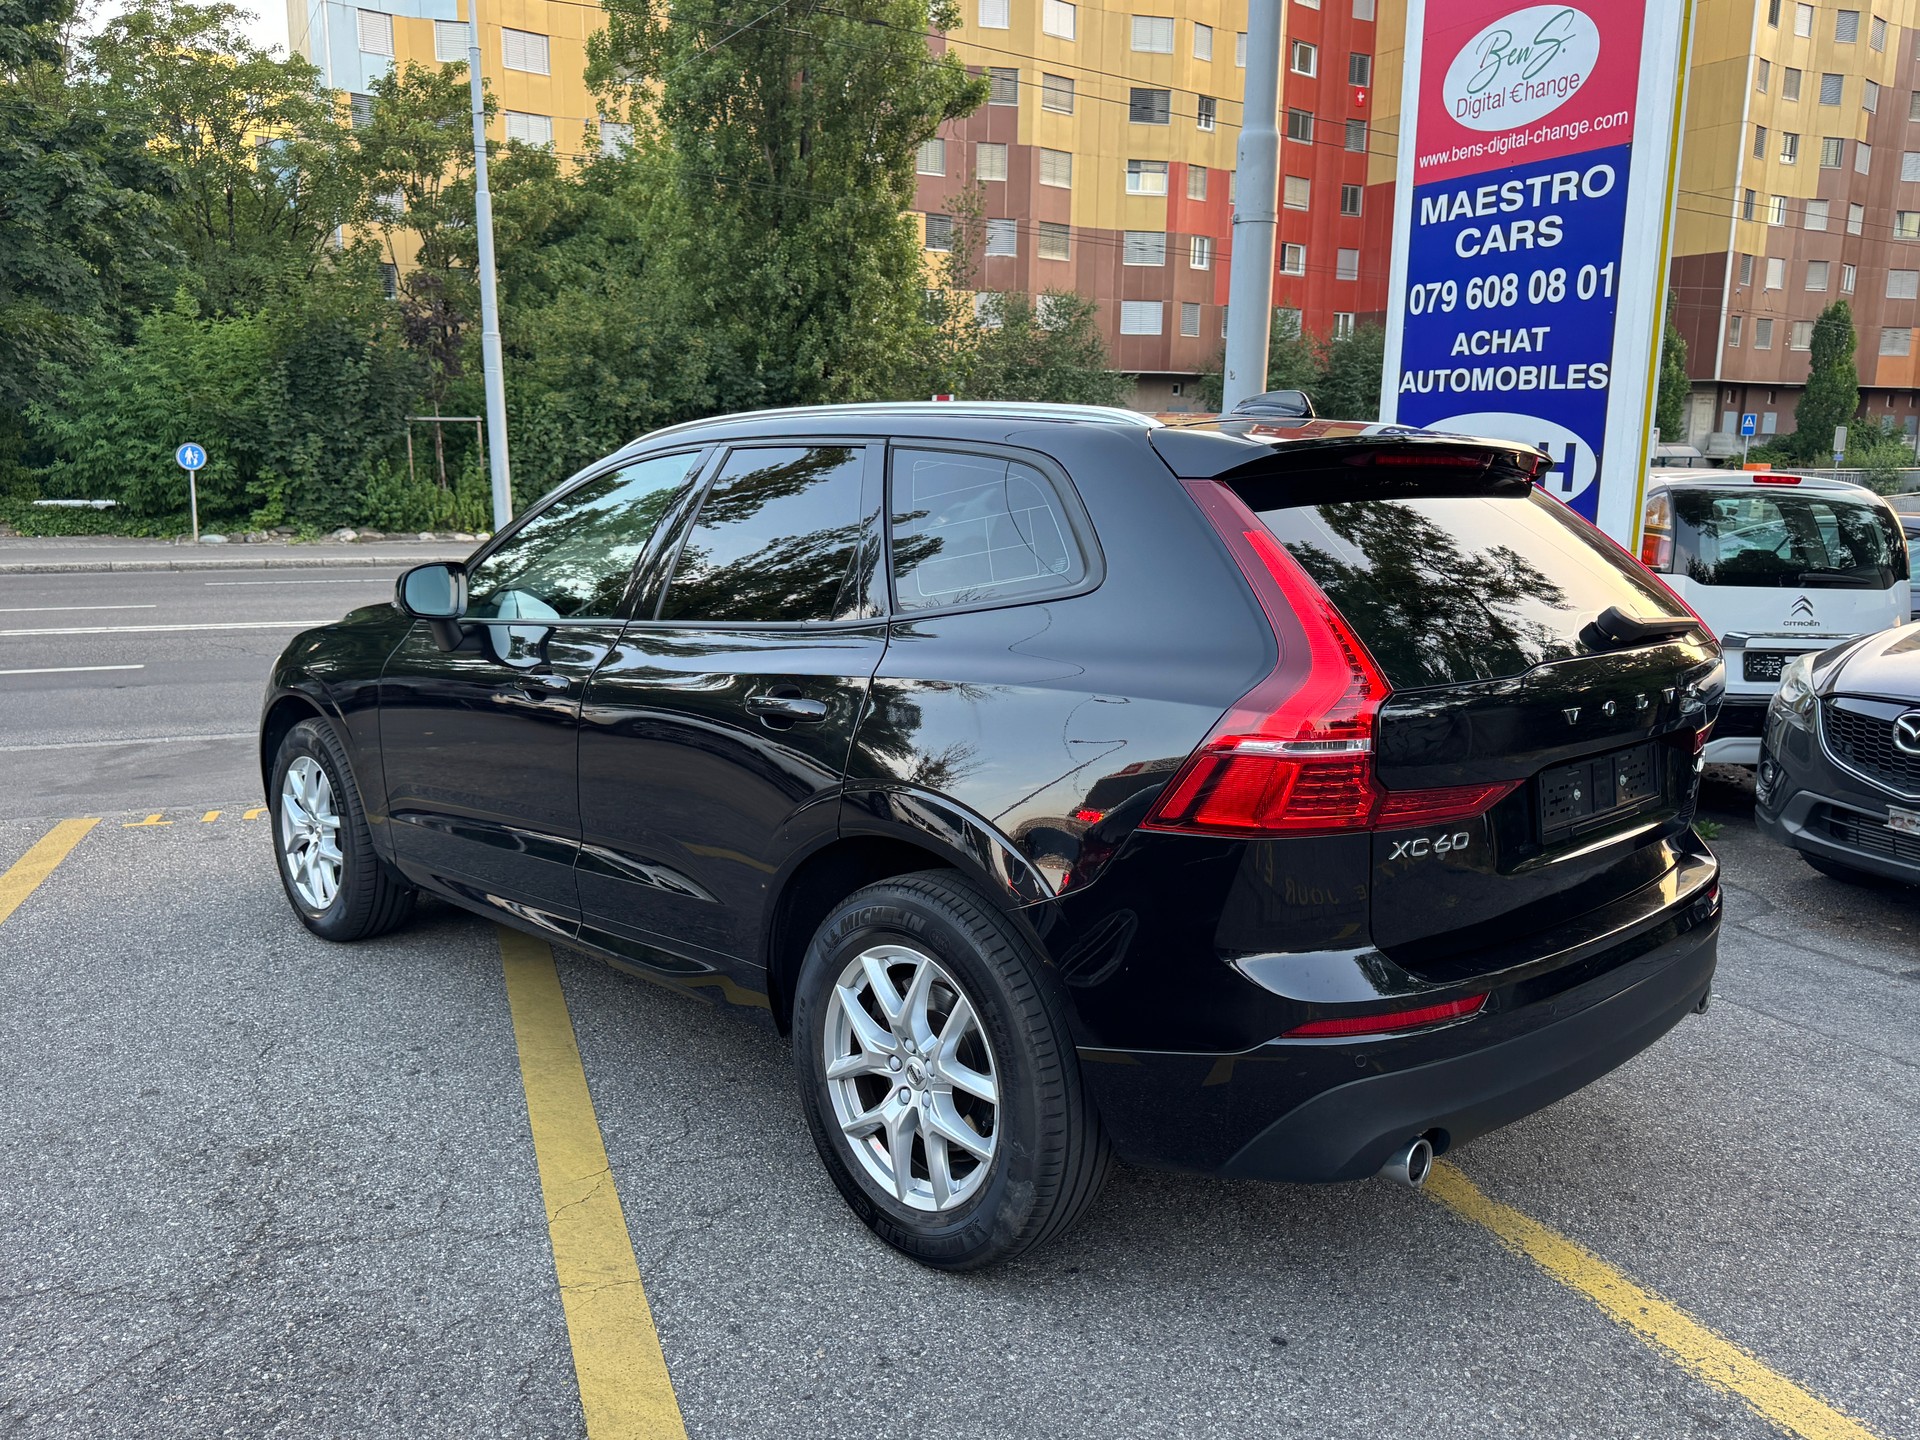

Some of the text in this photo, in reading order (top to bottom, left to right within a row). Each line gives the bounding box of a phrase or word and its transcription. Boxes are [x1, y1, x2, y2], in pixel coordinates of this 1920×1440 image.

[1456, 86, 1506, 119] Digital
[1419, 109, 1629, 169] www.bens-digital-change.com
[1420, 164, 1616, 226] MAESTRO
[1455, 215, 1564, 259] CARS
[1409, 261, 1615, 315] 079 608 08 01
[1450, 326, 1551, 356] ACHAT
[1399, 362, 1609, 394] AUTOMOBILES
[1561, 682, 1699, 726] VOLVO
[840, 906, 928, 936] MICHELIN
